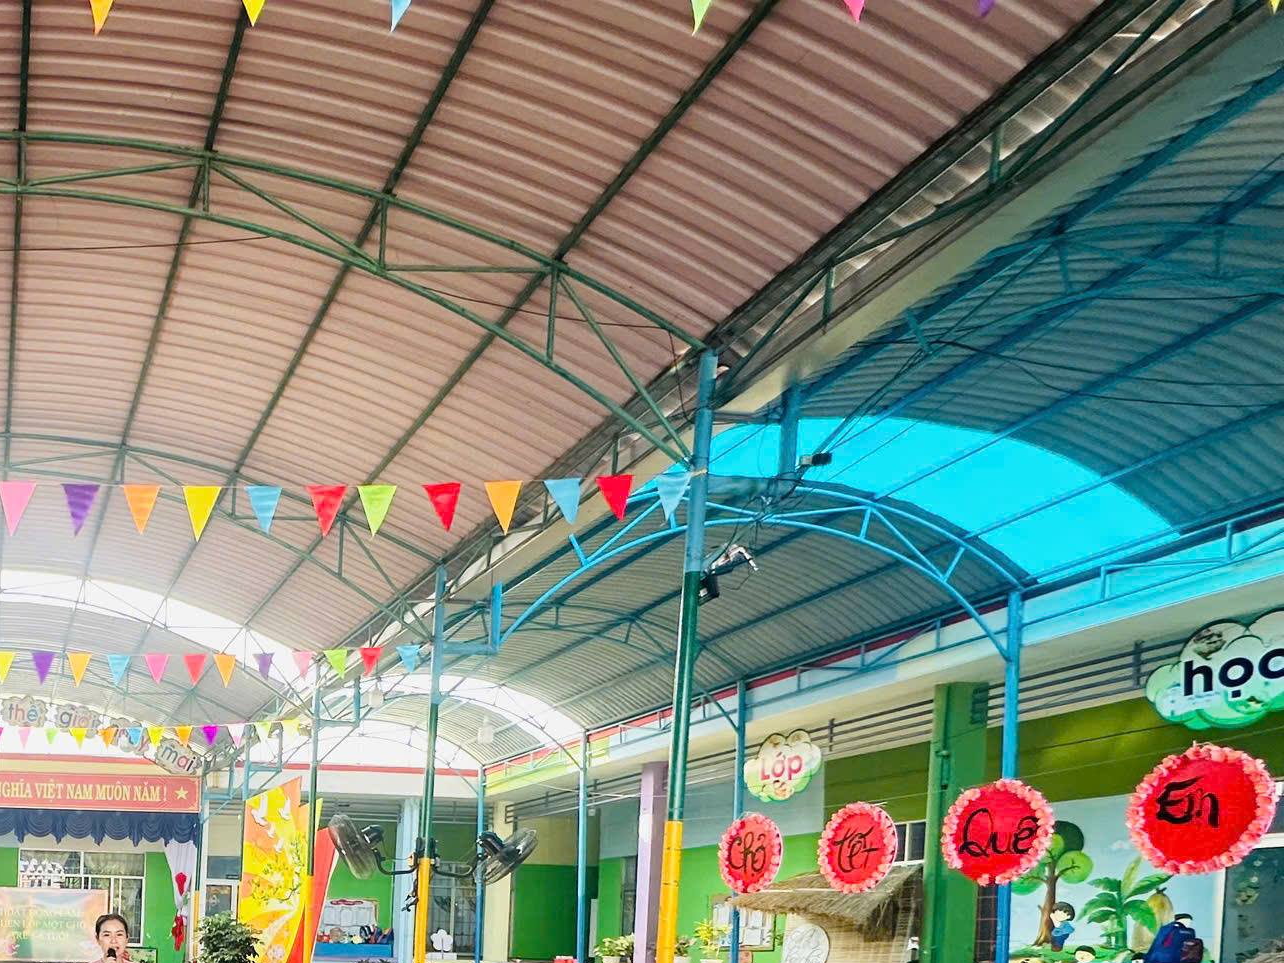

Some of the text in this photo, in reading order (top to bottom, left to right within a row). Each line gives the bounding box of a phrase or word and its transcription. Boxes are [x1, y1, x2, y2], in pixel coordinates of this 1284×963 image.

[1183, 648, 1284, 698] học
[161, 746, 196, 772] mai
[761, 751, 803, 780] Lớp
[35, 778, 63, 803] VIỆT
[66, 783, 93, 800] NAM
[95, 780, 131, 801] MUÔN
